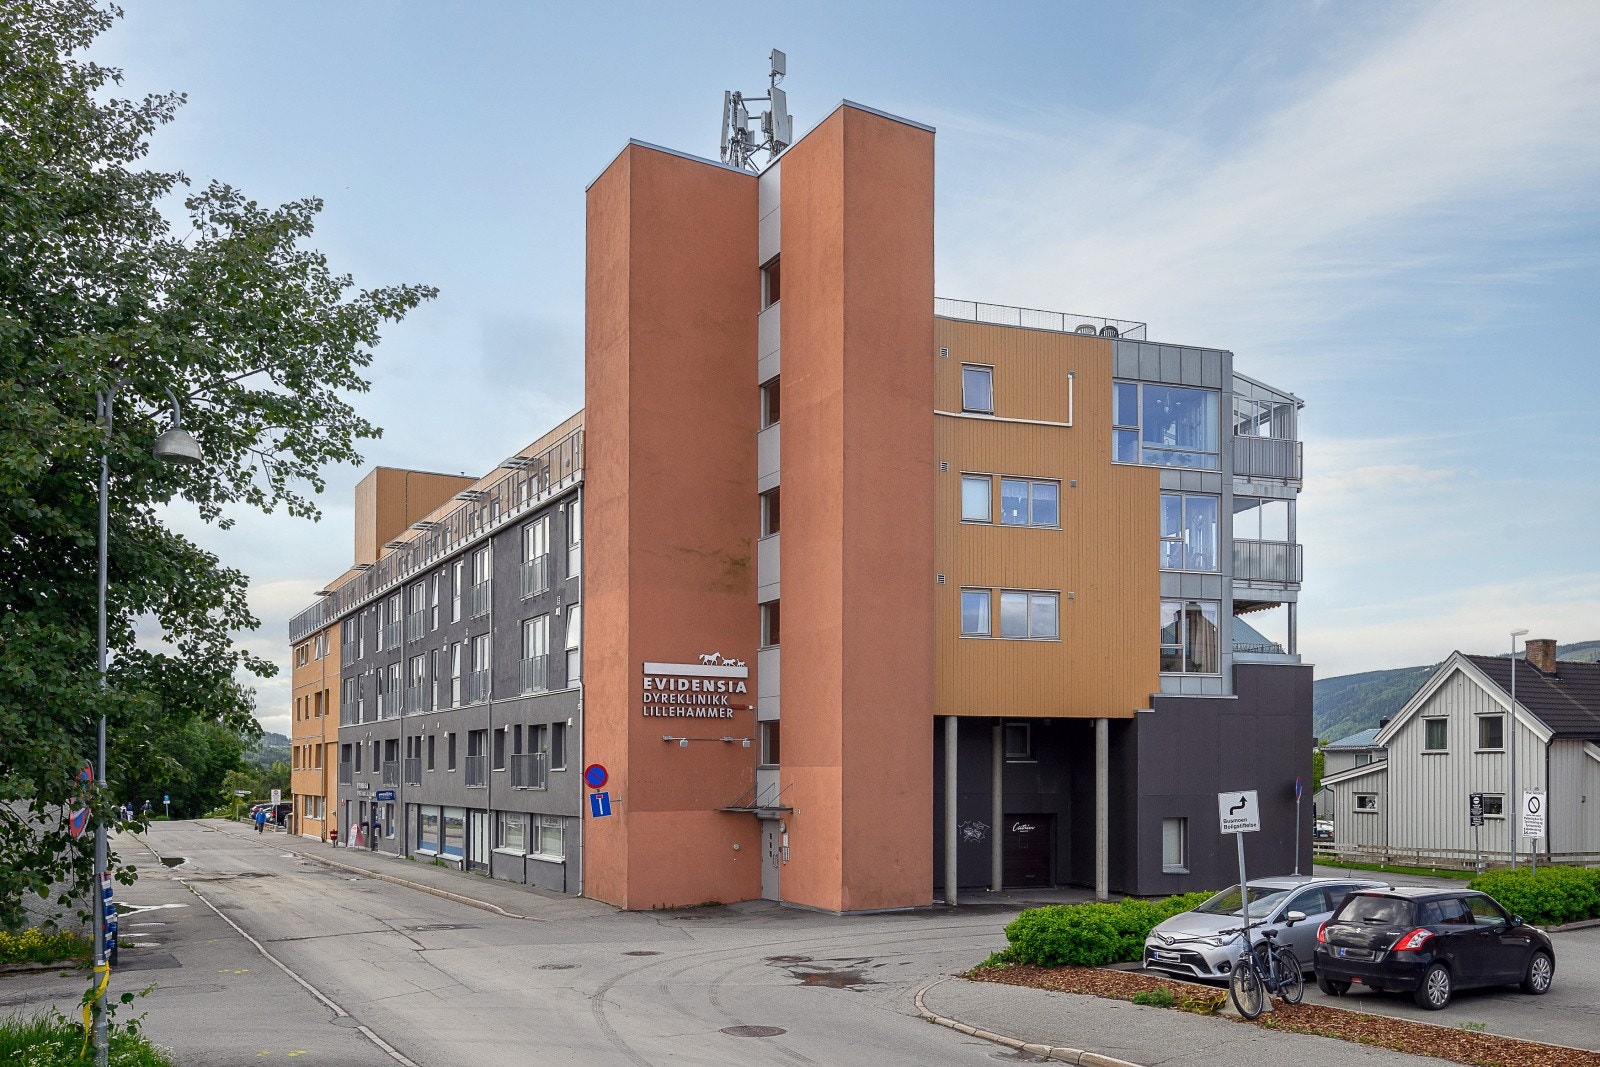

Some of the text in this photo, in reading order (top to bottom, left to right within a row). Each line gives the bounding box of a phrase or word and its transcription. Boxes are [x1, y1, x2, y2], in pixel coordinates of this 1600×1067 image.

[643, 677, 747, 693] EVIDENSIA
[643, 692, 728, 705] DYREKLINIKK
[643, 705, 734, 718] LILLEHAMMER
